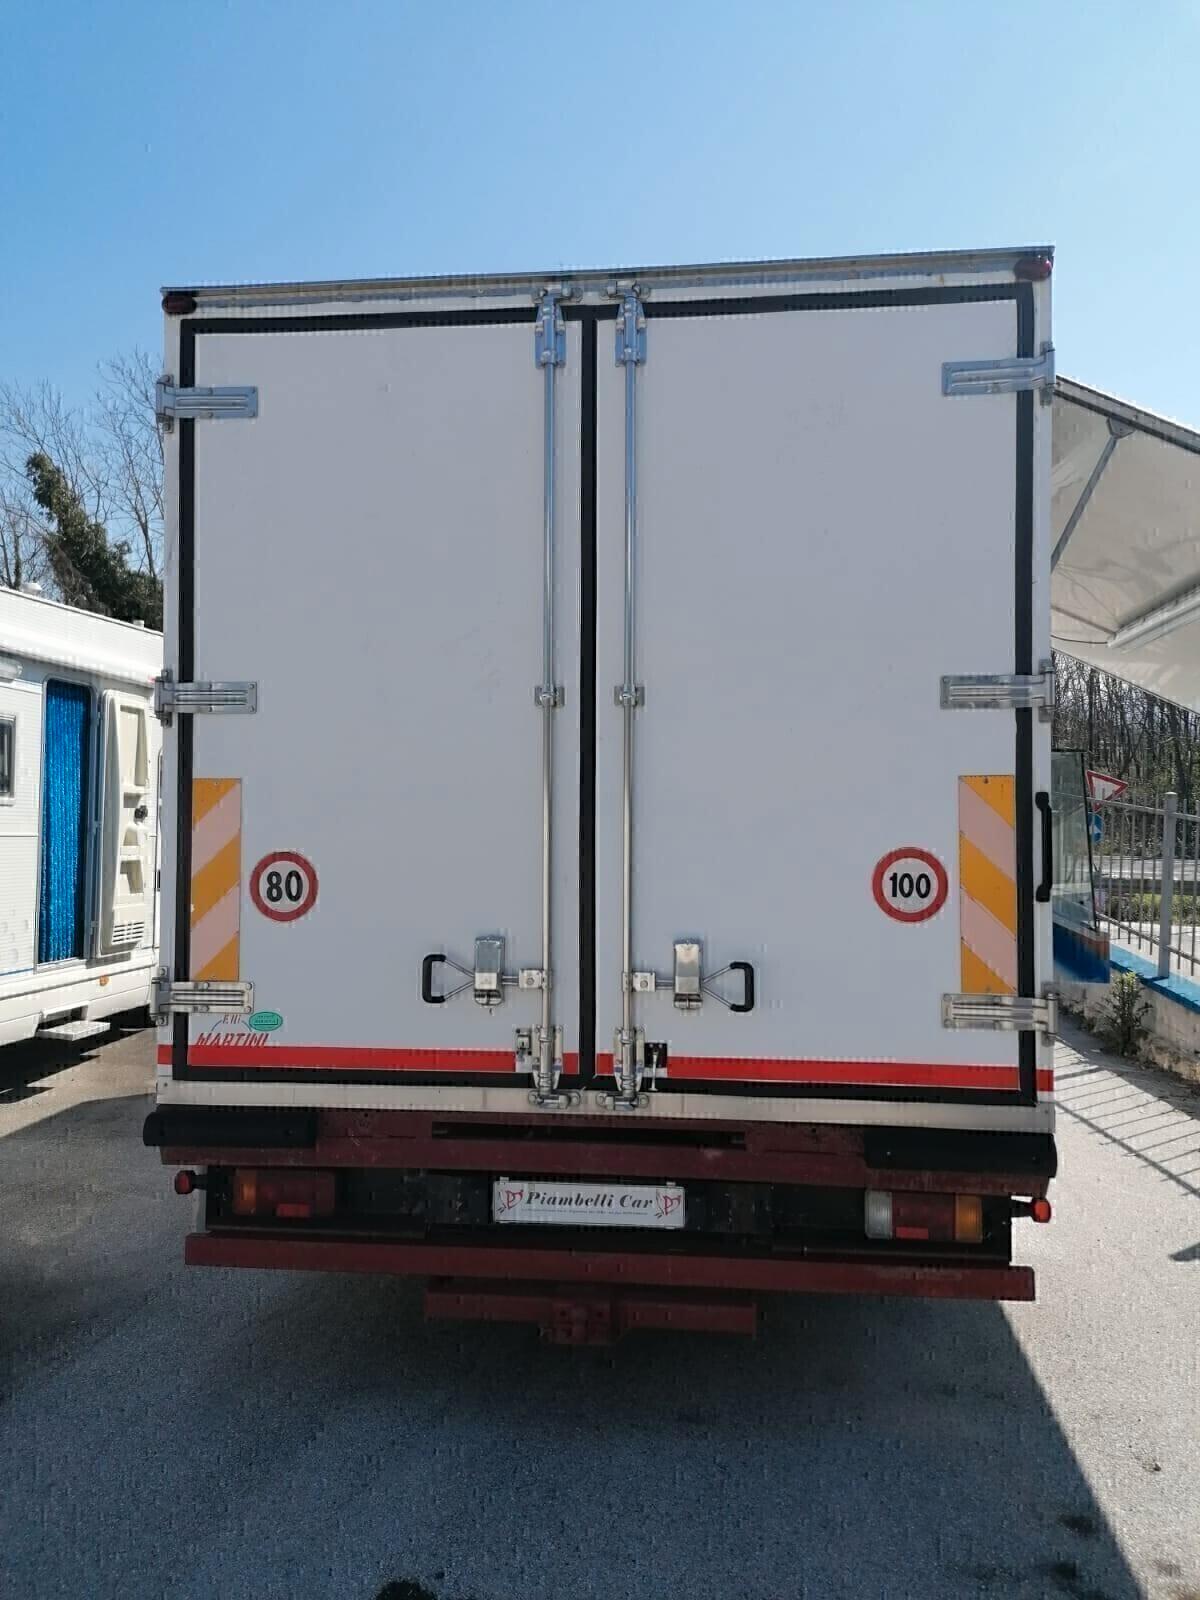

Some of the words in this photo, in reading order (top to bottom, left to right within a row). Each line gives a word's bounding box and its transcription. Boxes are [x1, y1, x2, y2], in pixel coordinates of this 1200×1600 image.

[266, 870, 303, 902] 80
[889, 872, 931, 898] 100
[196, 1033, 270, 1047] MARTINI
[526, 1191, 615, 1208] Piambelli
[619, 1194, 653, 1209] Car
